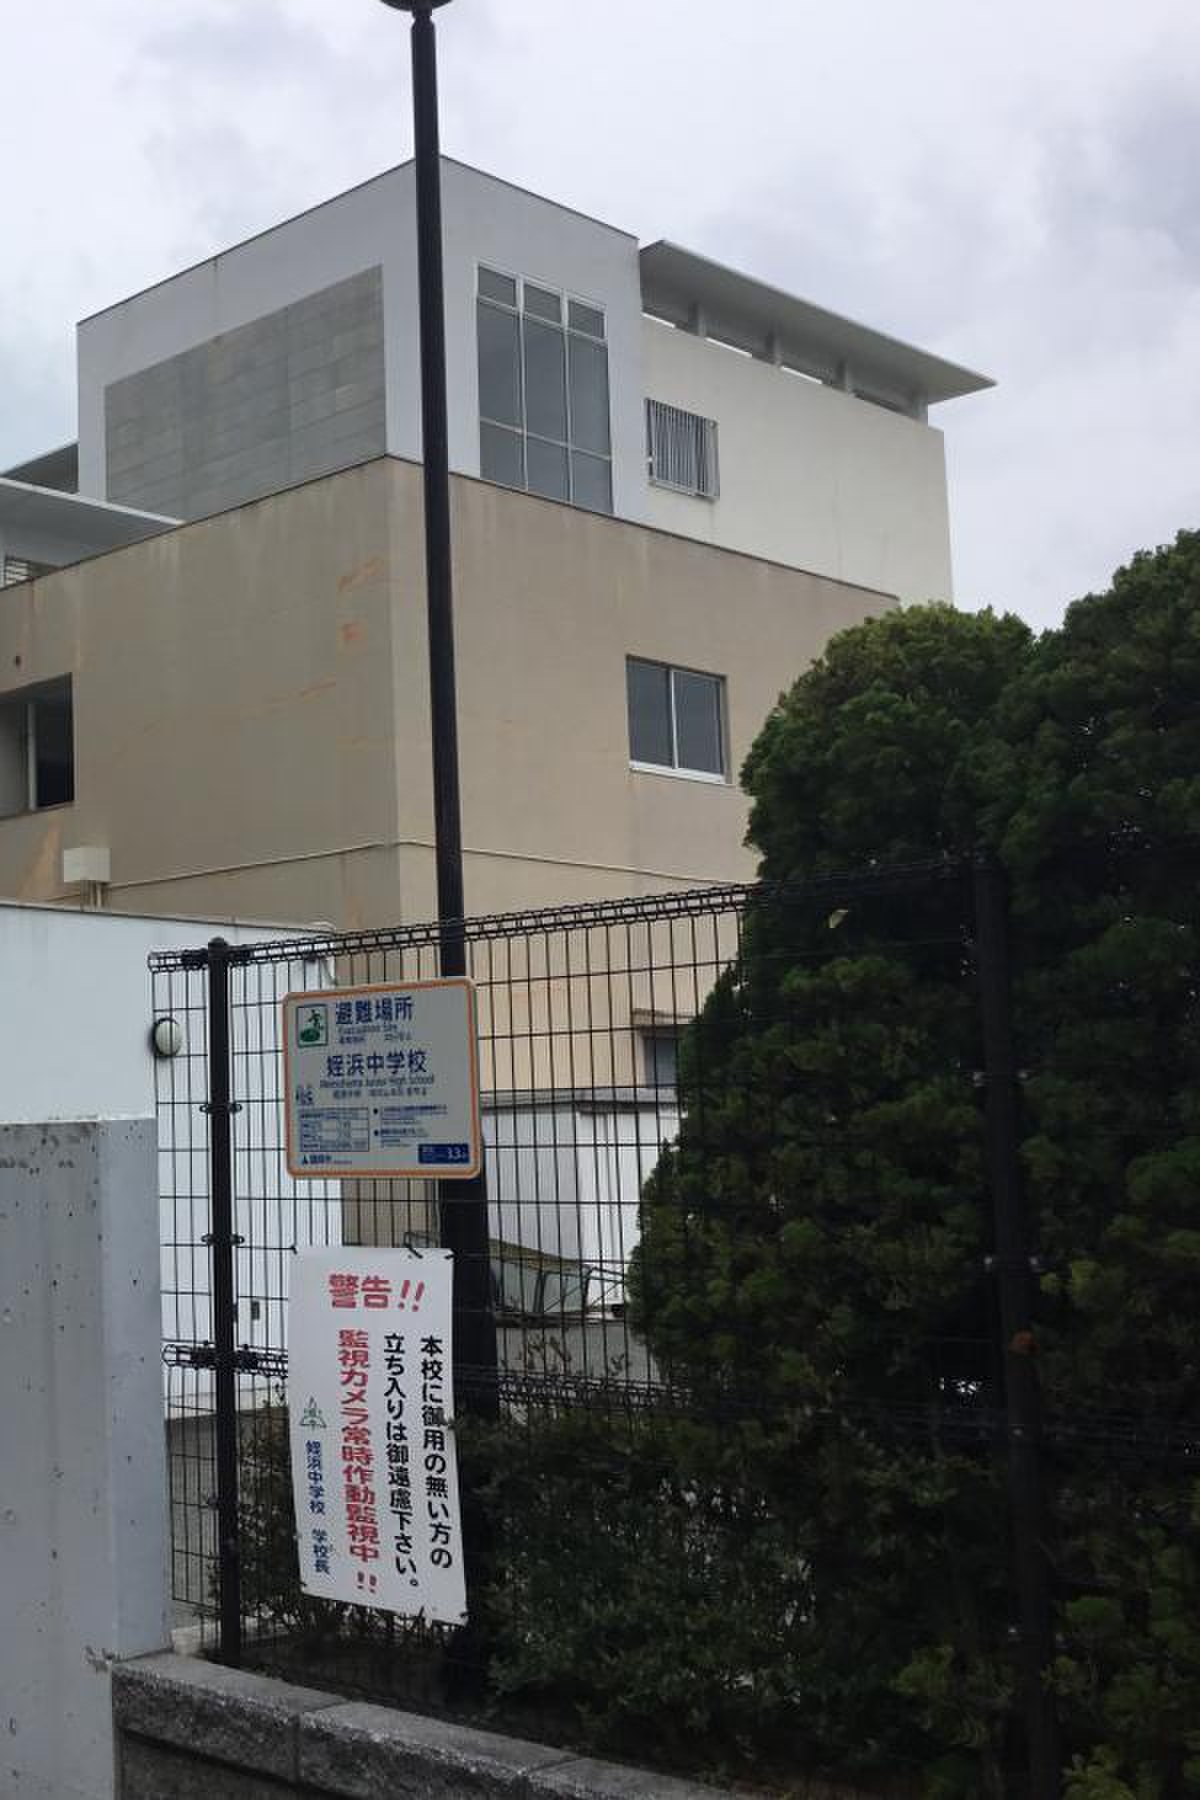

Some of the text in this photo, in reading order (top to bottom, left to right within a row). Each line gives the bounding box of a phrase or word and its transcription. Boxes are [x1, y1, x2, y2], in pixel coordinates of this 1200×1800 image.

[327, 1049, 427, 1077] 姪浜中学校
[336, 996, 414, 1024] 避難場所
[383, 1333, 419, 1587] 立ち入りは御遠慮下さい。
[420, 1335, 452, 1569] 本校に御用の無い方の
